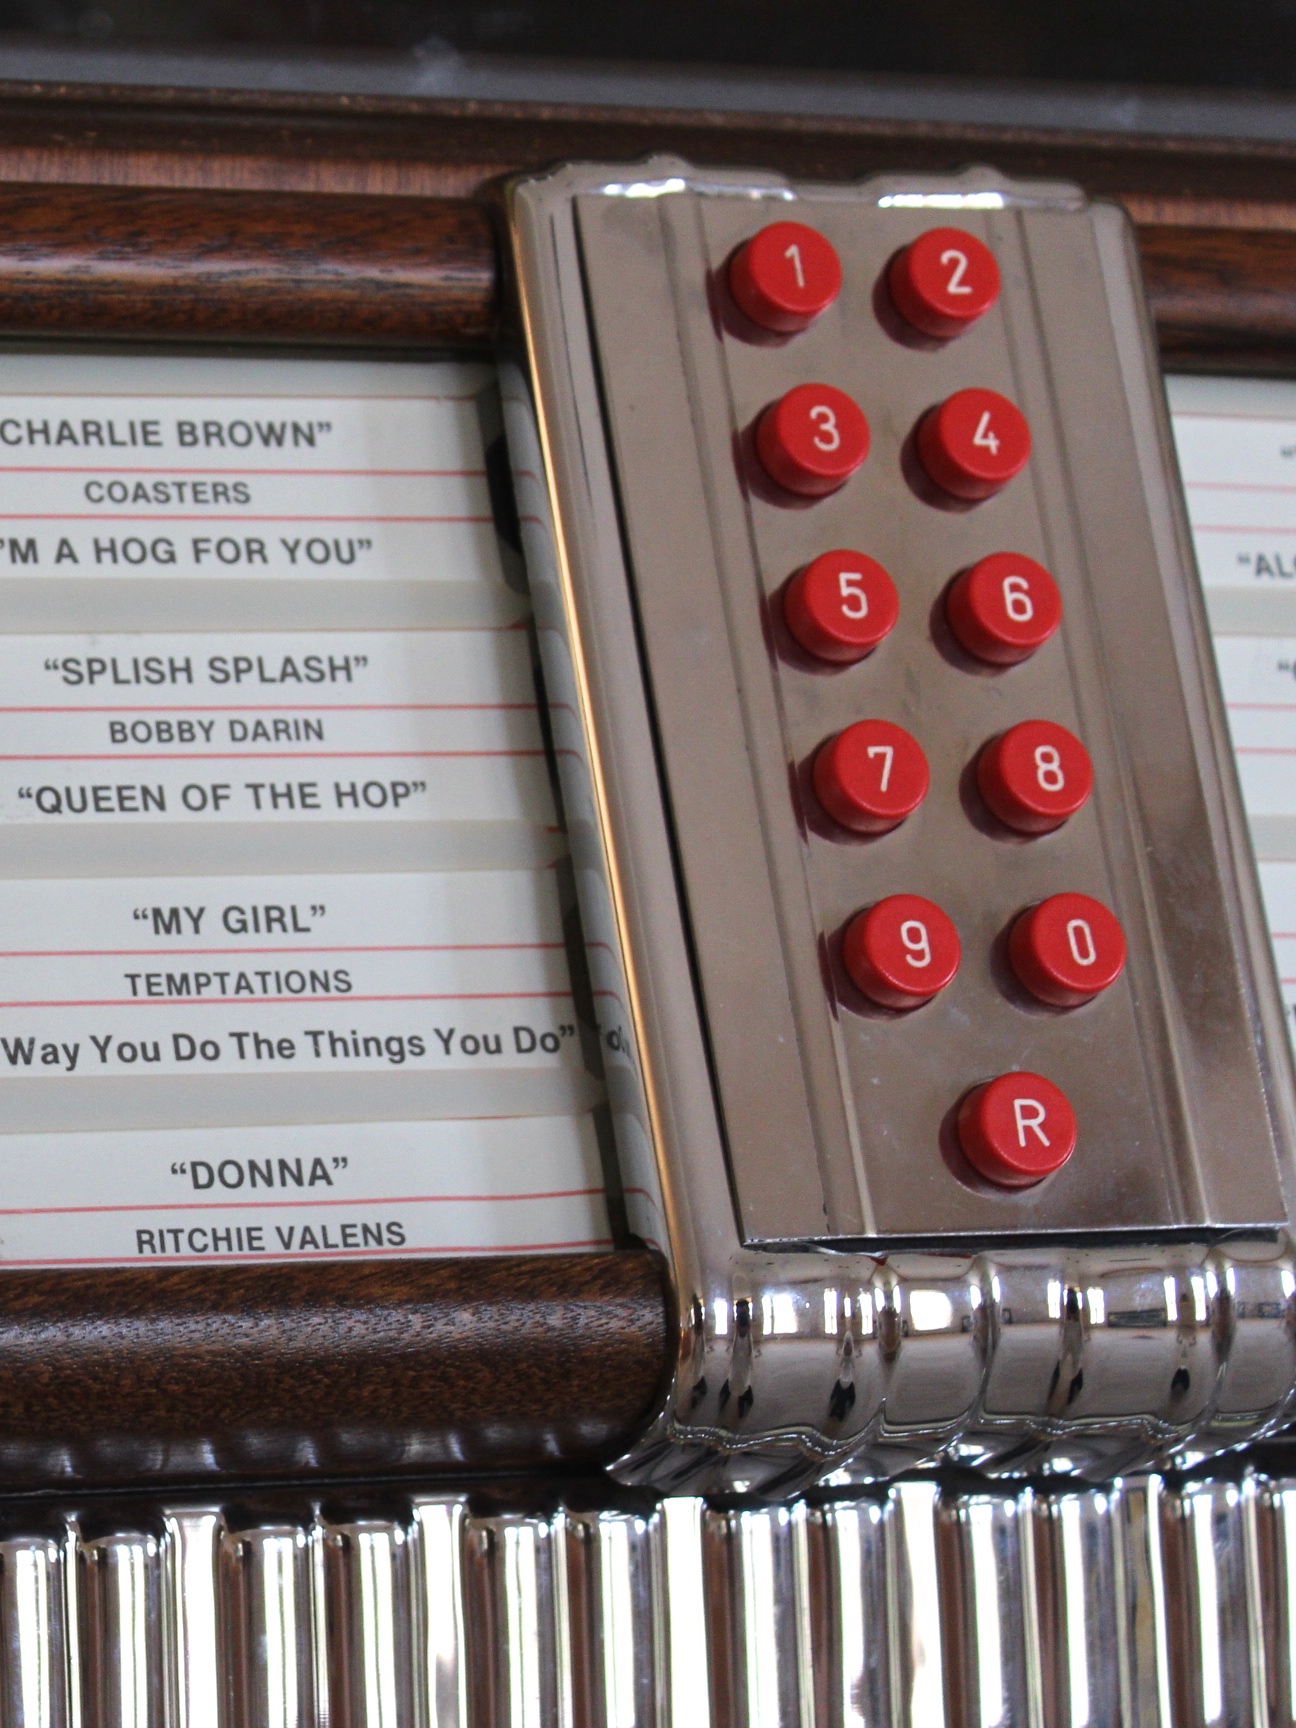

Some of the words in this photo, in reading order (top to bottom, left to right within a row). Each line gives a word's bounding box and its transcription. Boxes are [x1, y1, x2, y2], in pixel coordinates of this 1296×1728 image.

[785, 244, 805, 287] 1
[940, 249, 972, 295] 2
[176, 420, 332, 448] BROWN”
[810, 405, 840, 451] 3
[972, 411, 999, 454] 4
[84, 480, 251, 505] COASTERS
[54, 537, 79, 564] A
[93, 537, 177, 565] HOG
[191, 537, 269, 565] FOR
[280, 537, 373, 566] YOU”
[1237, 552, 1296, 579] “AL
[838, 571, 868, 619] 5
[1002, 575, 1034, 622] 6
[44, 656, 194, 686] “SPLISH
[208, 655, 368, 685] SPLASH”
[109, 720, 215, 744] BOBBY
[228, 718, 324, 743] DARIN
[867, 745, 894, 792] 7
[1034, 745, 1065, 792] 8
[18, 784, 167, 815] “QUEEN
[181, 783, 231, 812] OF
[244, 781, 321, 810] THE
[334, 780, 427, 809] HOP”
[133, 906, 206, 936] “MY
[222, 904, 326, 935] GIRL”
[900, 919, 932, 968] 9
[1066, 918, 1097, 966] 0
[123, 969, 353, 997] TEMPTATIONS
[0, 1037, 80, 1072] Way
[89, 1034, 161, 1064] You
[172, 1033, 221, 1062] Do
[228, 1031, 296, 1060] The
[303, 1029, 426, 1065] Things
[433, 1027, 503, 1056] You
[512, 1024, 576, 1055] Do”
[1013, 1098, 1051, 1148] R
[170, 1156, 348, 1190] “DONNA”
[135, 1226, 266, 1255] RITCHIE
[274, 1221, 406, 1251] VALENS
